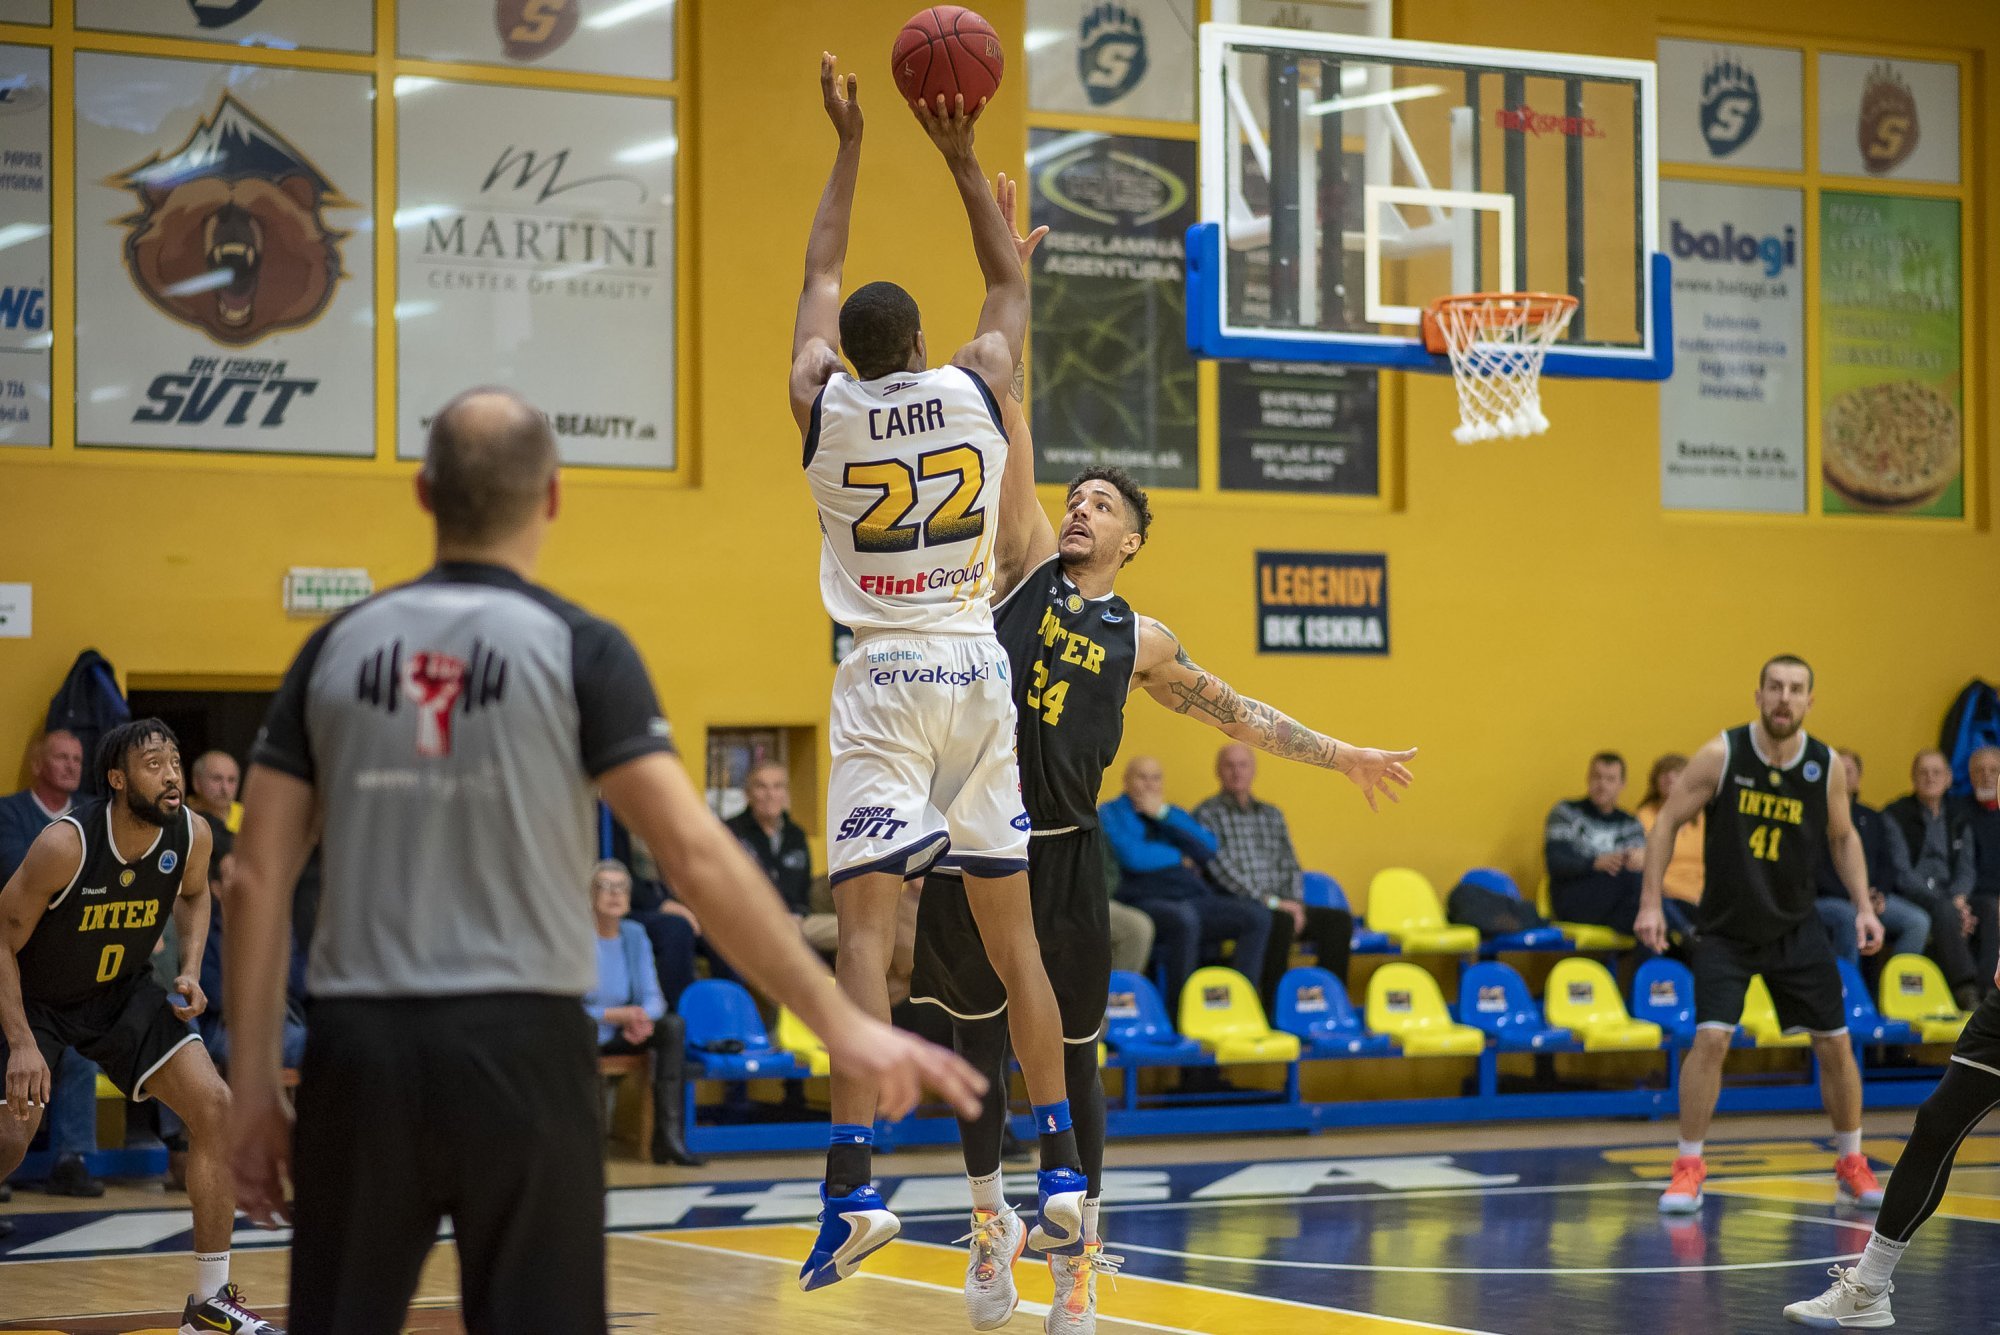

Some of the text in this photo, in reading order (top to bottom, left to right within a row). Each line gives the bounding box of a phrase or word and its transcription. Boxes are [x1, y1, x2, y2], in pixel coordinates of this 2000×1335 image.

[422, 215, 657, 268] MARTINI
[1670, 218, 1796, 278] balogi
[427, 270, 517, 291] CENTER
[565, 278, 651, 299] BEAUTY
[221, 356, 288, 376] ISKRA
[868, 398, 946, 441] CARR
[842, 442, 986, 553] 22
[1261, 564, 1382, 608] LEGENDY
[1263, 614, 1384, 649] BK ISKRA
[848, 806, 897, 819] ISKRA
[1738, 787, 1804, 826] INTER
[834, 817, 909, 843] SVIT
[1748, 824, 1783, 862] 41
[78, 898, 160, 932] INTER
[96, 943, 126, 983] 0
